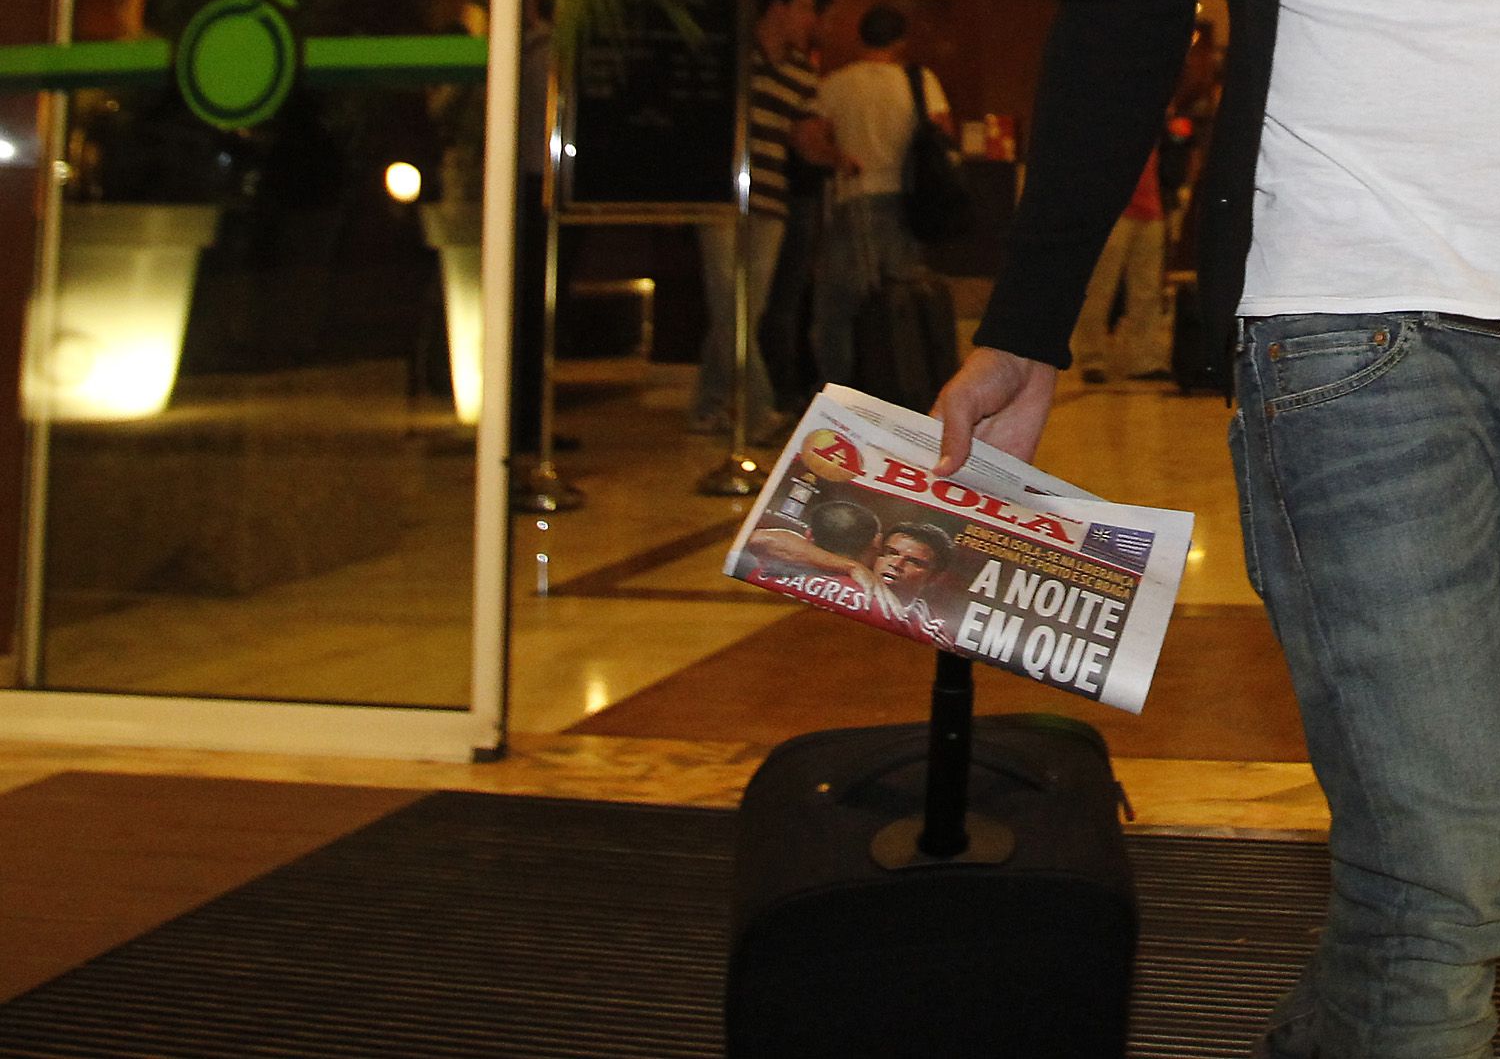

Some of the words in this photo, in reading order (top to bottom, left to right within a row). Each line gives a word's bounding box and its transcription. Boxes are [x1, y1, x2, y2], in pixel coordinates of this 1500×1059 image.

[813, 434, 866, 476] A
[875, 457, 1074, 545] BOLA
[968, 559, 1001, 599] A
[1003, 568, 1126, 639] NOITE
[954, 601, 1025, 663] EM
[1022, 625, 1111, 694] QUE
